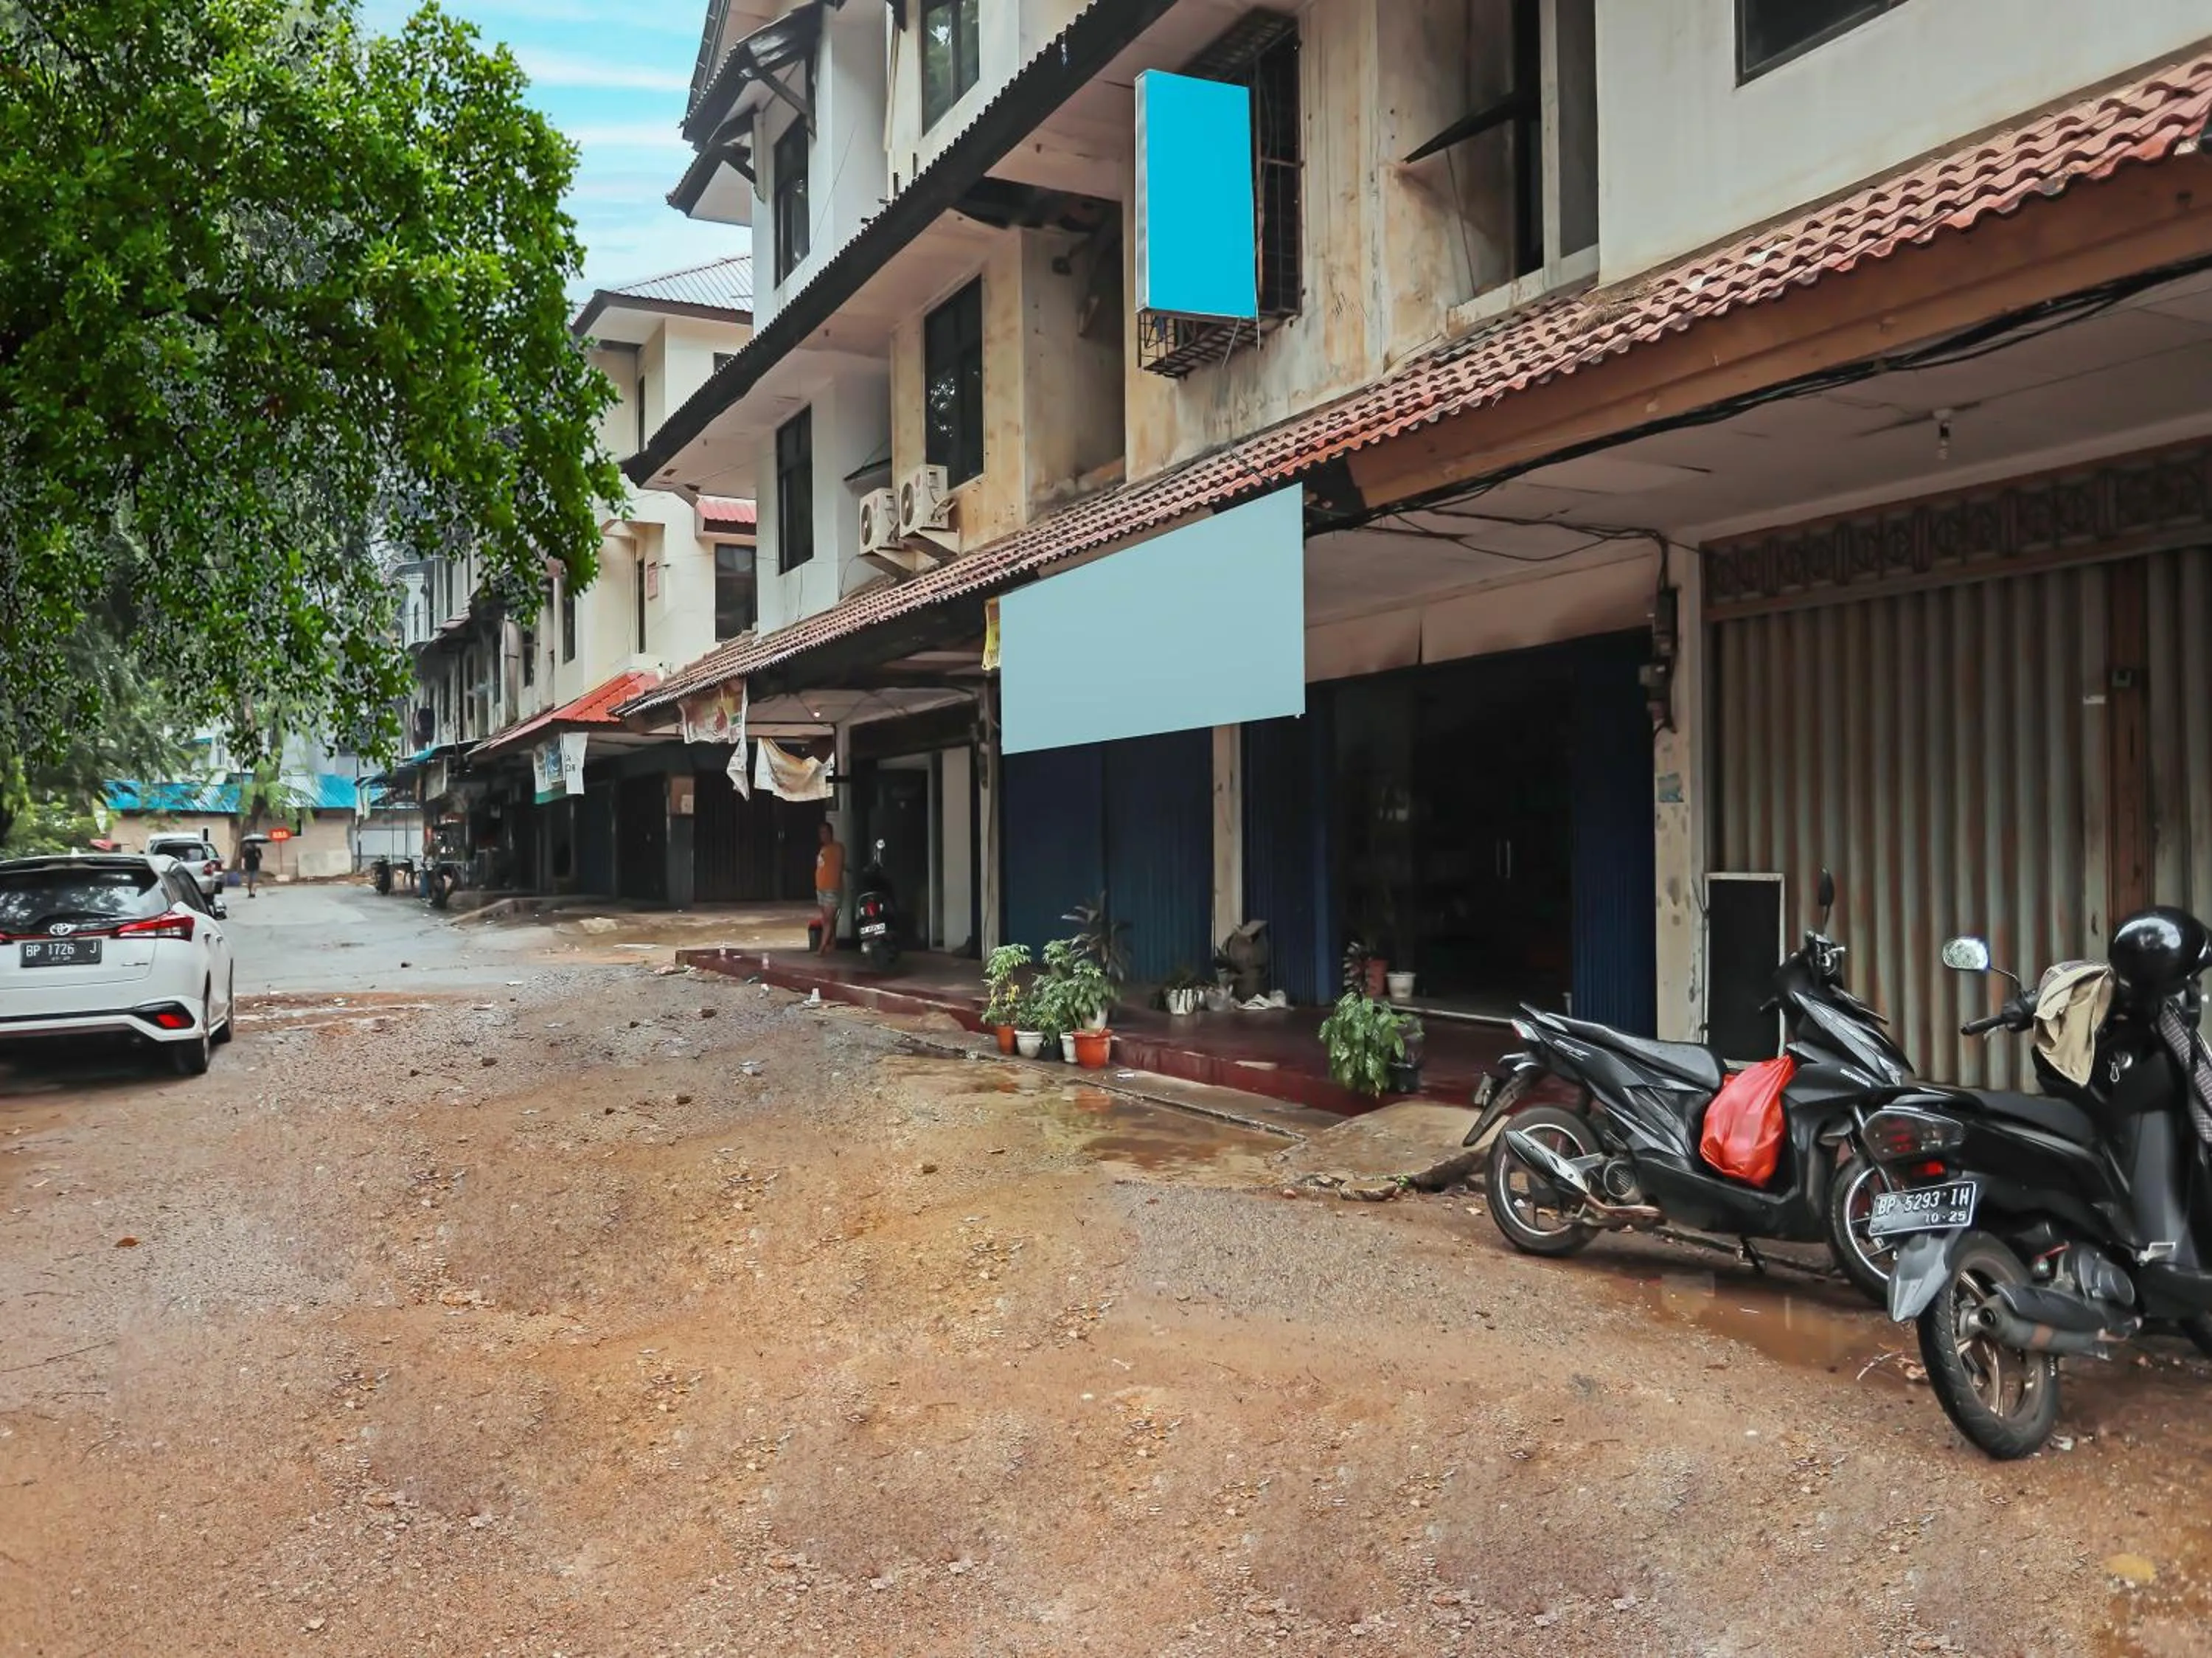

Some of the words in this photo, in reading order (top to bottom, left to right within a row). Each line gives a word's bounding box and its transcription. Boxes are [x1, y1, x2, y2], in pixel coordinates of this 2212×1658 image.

[26, 945, 41, 957] BP
[48, 944, 75, 955] 1726
[89, 942, 97, 954] J
[1878, 1197, 1896, 1215] BP
[1904, 1190, 1940, 1213] 5293
[1951, 1187, 1969, 1206] IH
